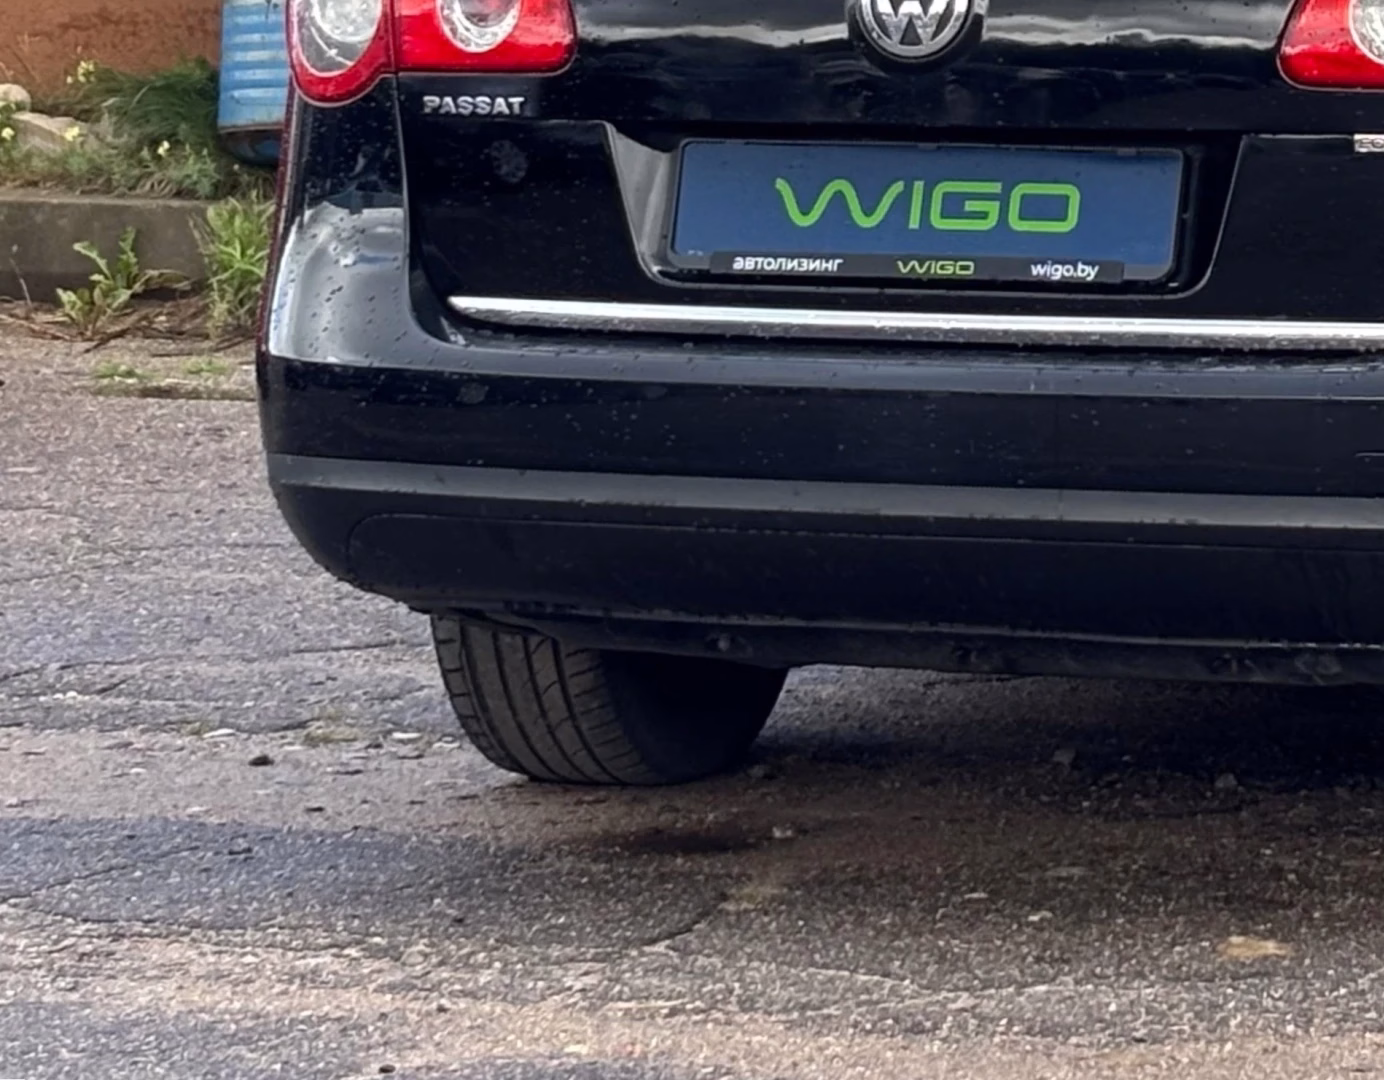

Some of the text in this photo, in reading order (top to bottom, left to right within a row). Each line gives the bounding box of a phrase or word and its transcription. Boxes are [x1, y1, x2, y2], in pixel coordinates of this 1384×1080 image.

[422, 95, 525, 116] PASSAT
[774, 177, 1081, 233] WIGO
[732, 255, 1099, 280] автолизинг WIGO wigo.by
